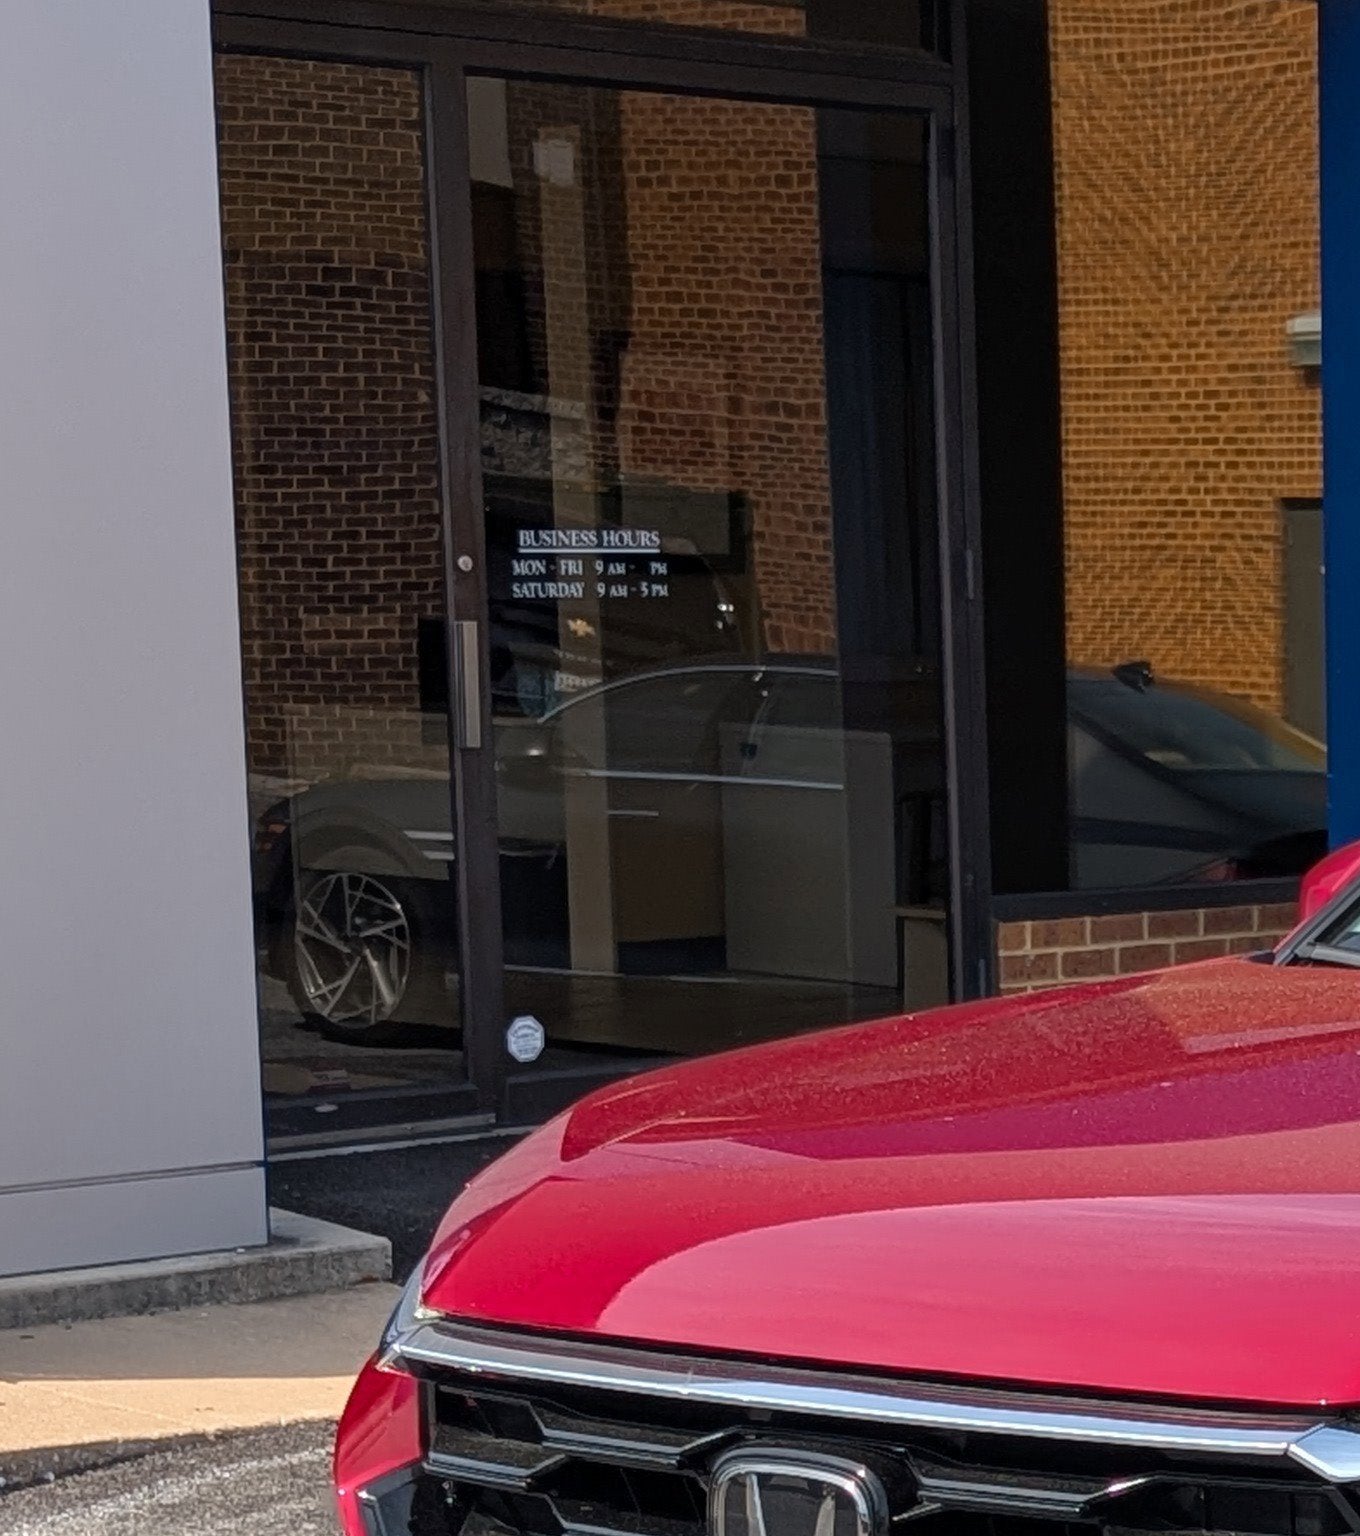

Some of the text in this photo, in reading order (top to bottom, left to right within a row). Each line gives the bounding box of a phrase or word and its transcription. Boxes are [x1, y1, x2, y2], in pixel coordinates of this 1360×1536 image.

[518, 529, 661, 547] BUSINESS HOURS
[511, 559, 546, 576] MON
[560, 559, 584, 576] FRI
[594, 560, 604, 576] 9
[607, 562, 626, 575] AM
[650, 561, 668, 576] PM
[511, 582, 585, 599] SATURDAY
[597, 582, 606, 598] 9
[609, 584, 628, 599] AM
[641, 582, 649, 598] 5
[651, 584, 669, 598] PM
